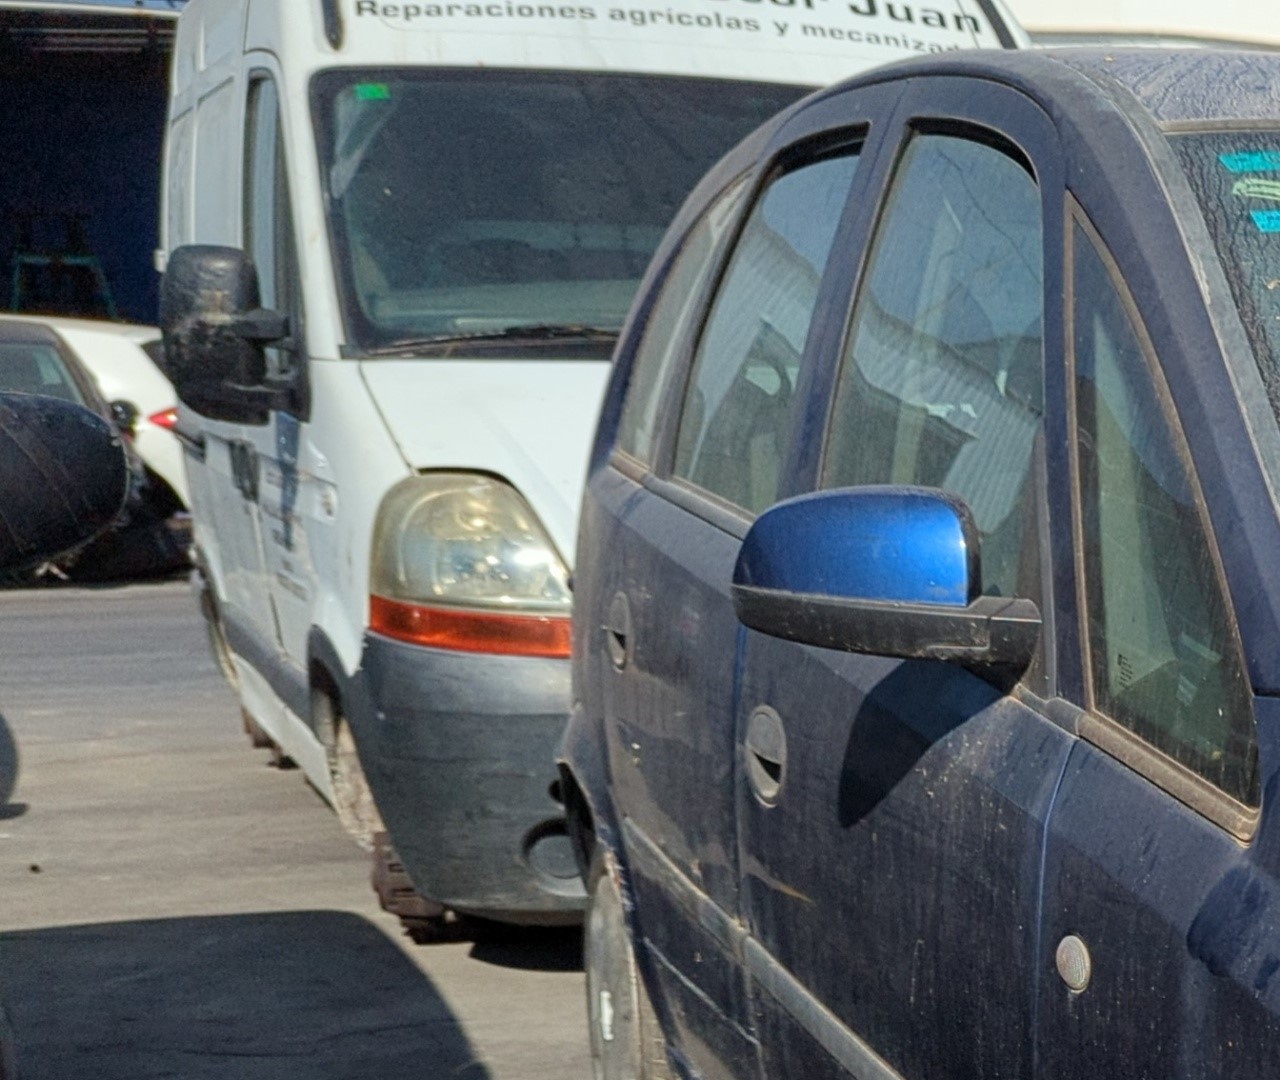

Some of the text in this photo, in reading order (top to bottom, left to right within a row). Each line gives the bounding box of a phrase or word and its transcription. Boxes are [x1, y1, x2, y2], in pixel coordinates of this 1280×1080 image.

[355, 0, 597, 21] Reparaciones
[773, 20, 789, 36] y
[849, 0, 981, 33] Juan
